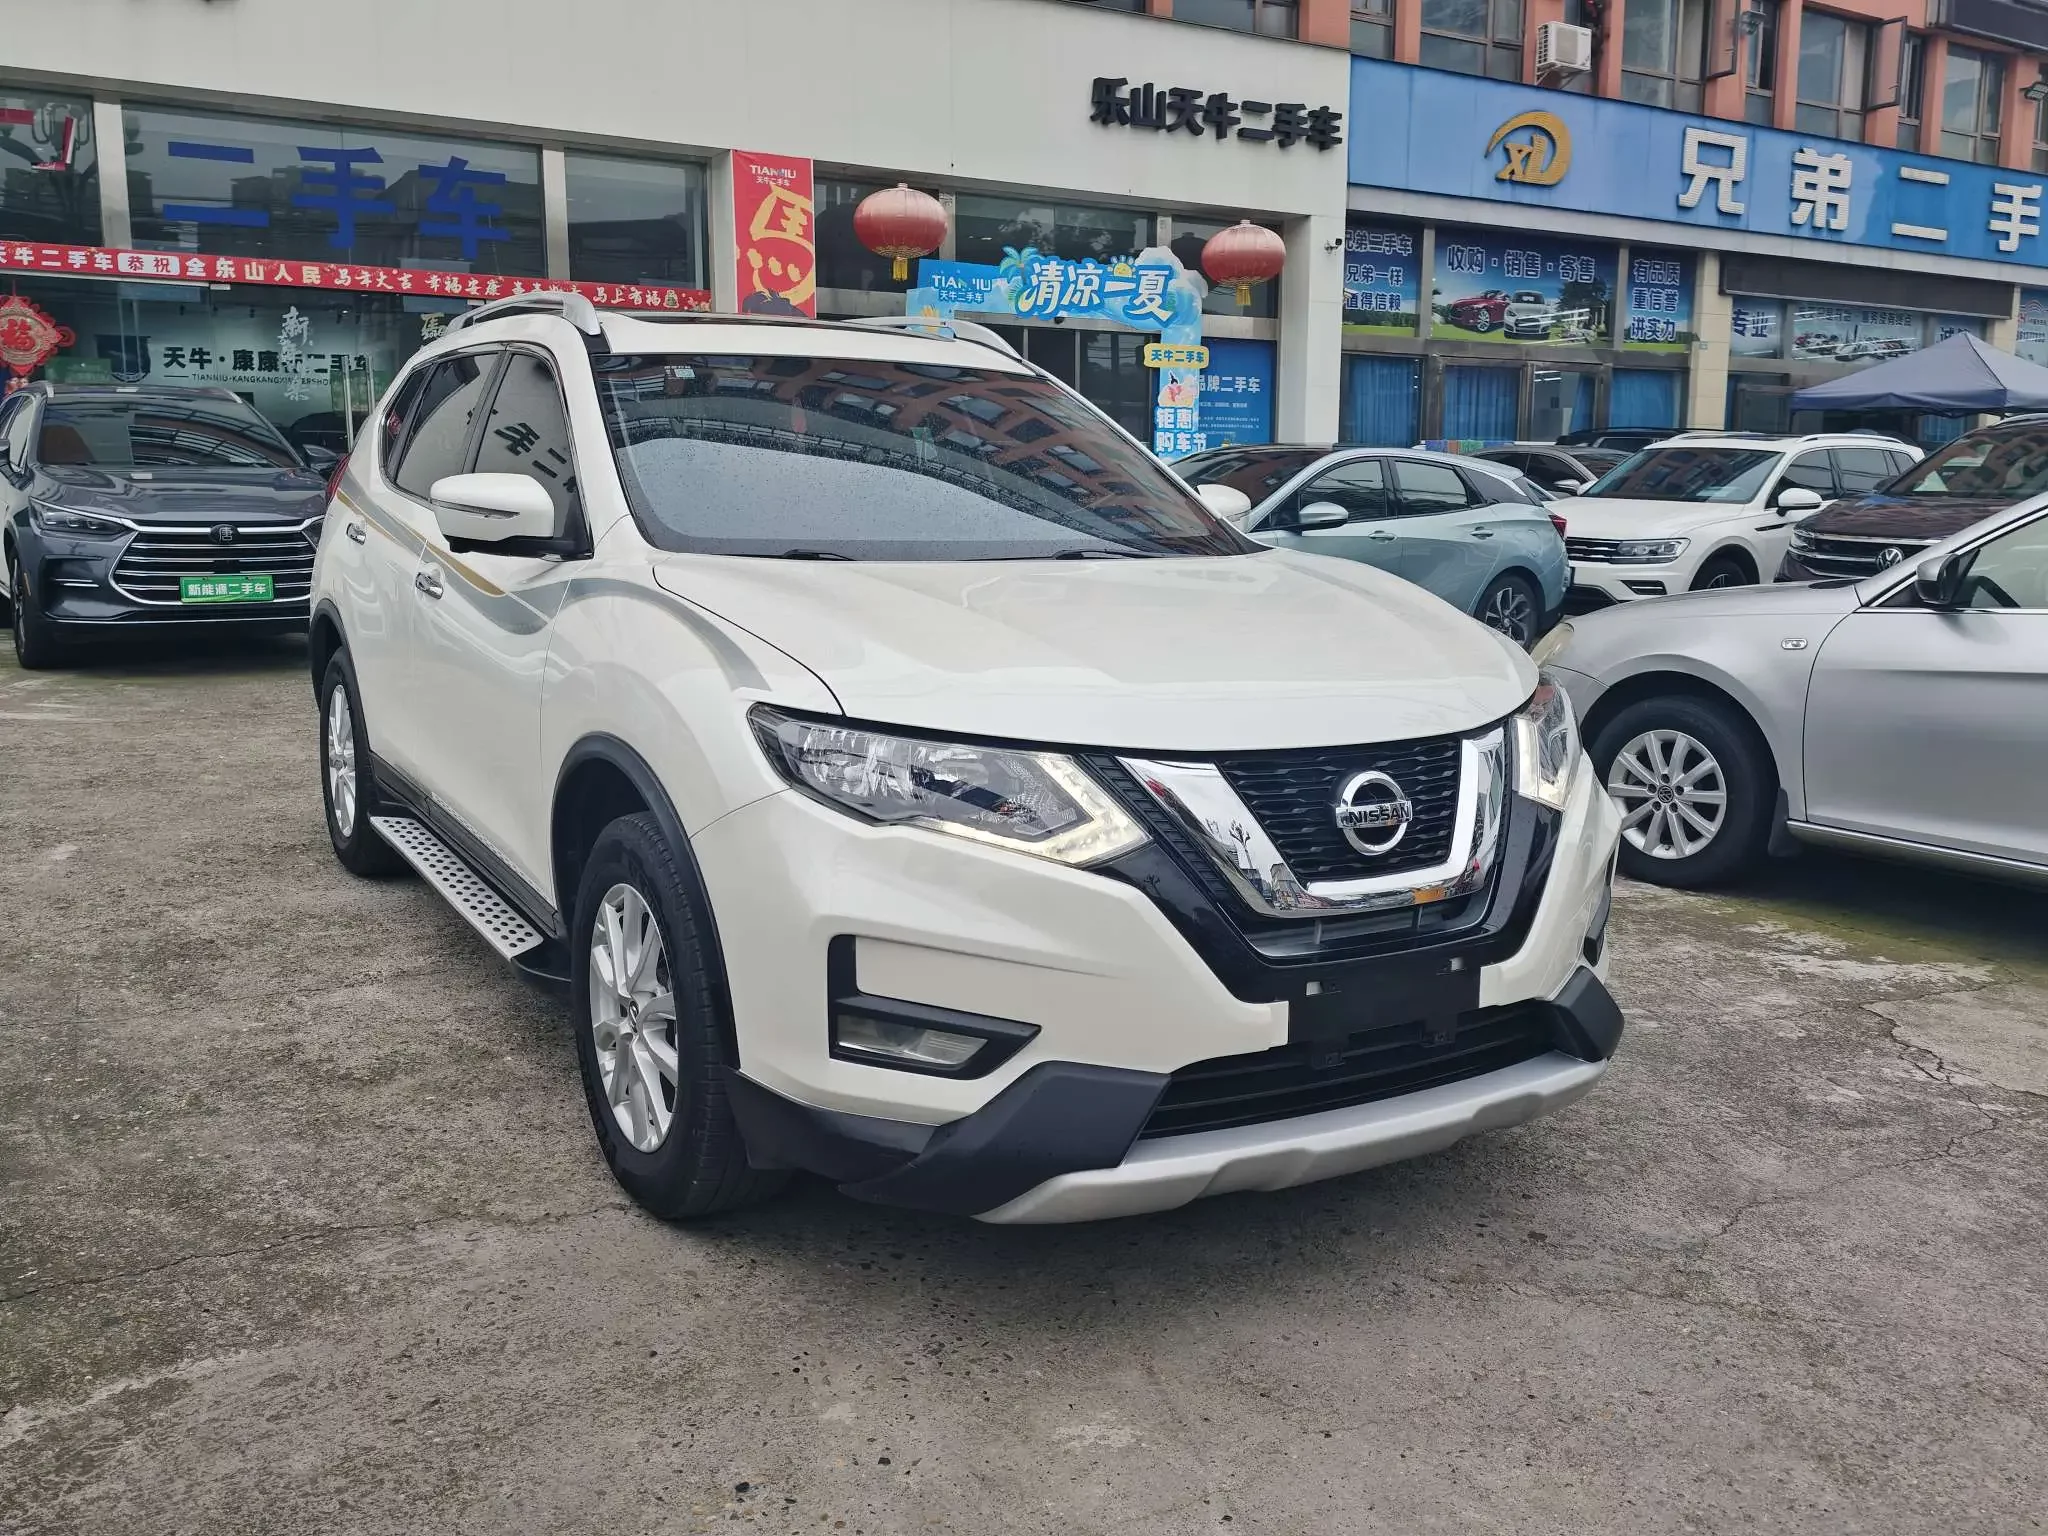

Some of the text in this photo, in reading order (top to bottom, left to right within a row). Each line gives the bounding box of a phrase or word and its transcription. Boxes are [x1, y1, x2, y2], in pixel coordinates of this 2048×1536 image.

[1091, 77, 1343, 151] 乐山天牛二手车
[163, 141, 512, 260] 二手车
[1678, 126, 2043, 252] 兄弟二手
[127, 256, 171, 273] 恭祝
[1346, 264, 1404, 287] 兄弟一样
[1633, 258, 1681, 286] 有品质
[939, 290, 984, 304] 天牛二手车
[1019, 261, 1174, 322] 清凉一夏
[1631, 287, 1679, 313] 重信誉
[1629, 316, 1677, 342] 讲实力
[1732, 308, 1768, 338] 专业
[1151, 349, 1204, 362] 天牛二手车
[1156, 431, 1207, 452] 购车节
[187, 583, 266, 595] 新能源二手车
[1349, 805, 1410, 823] NISSAN
